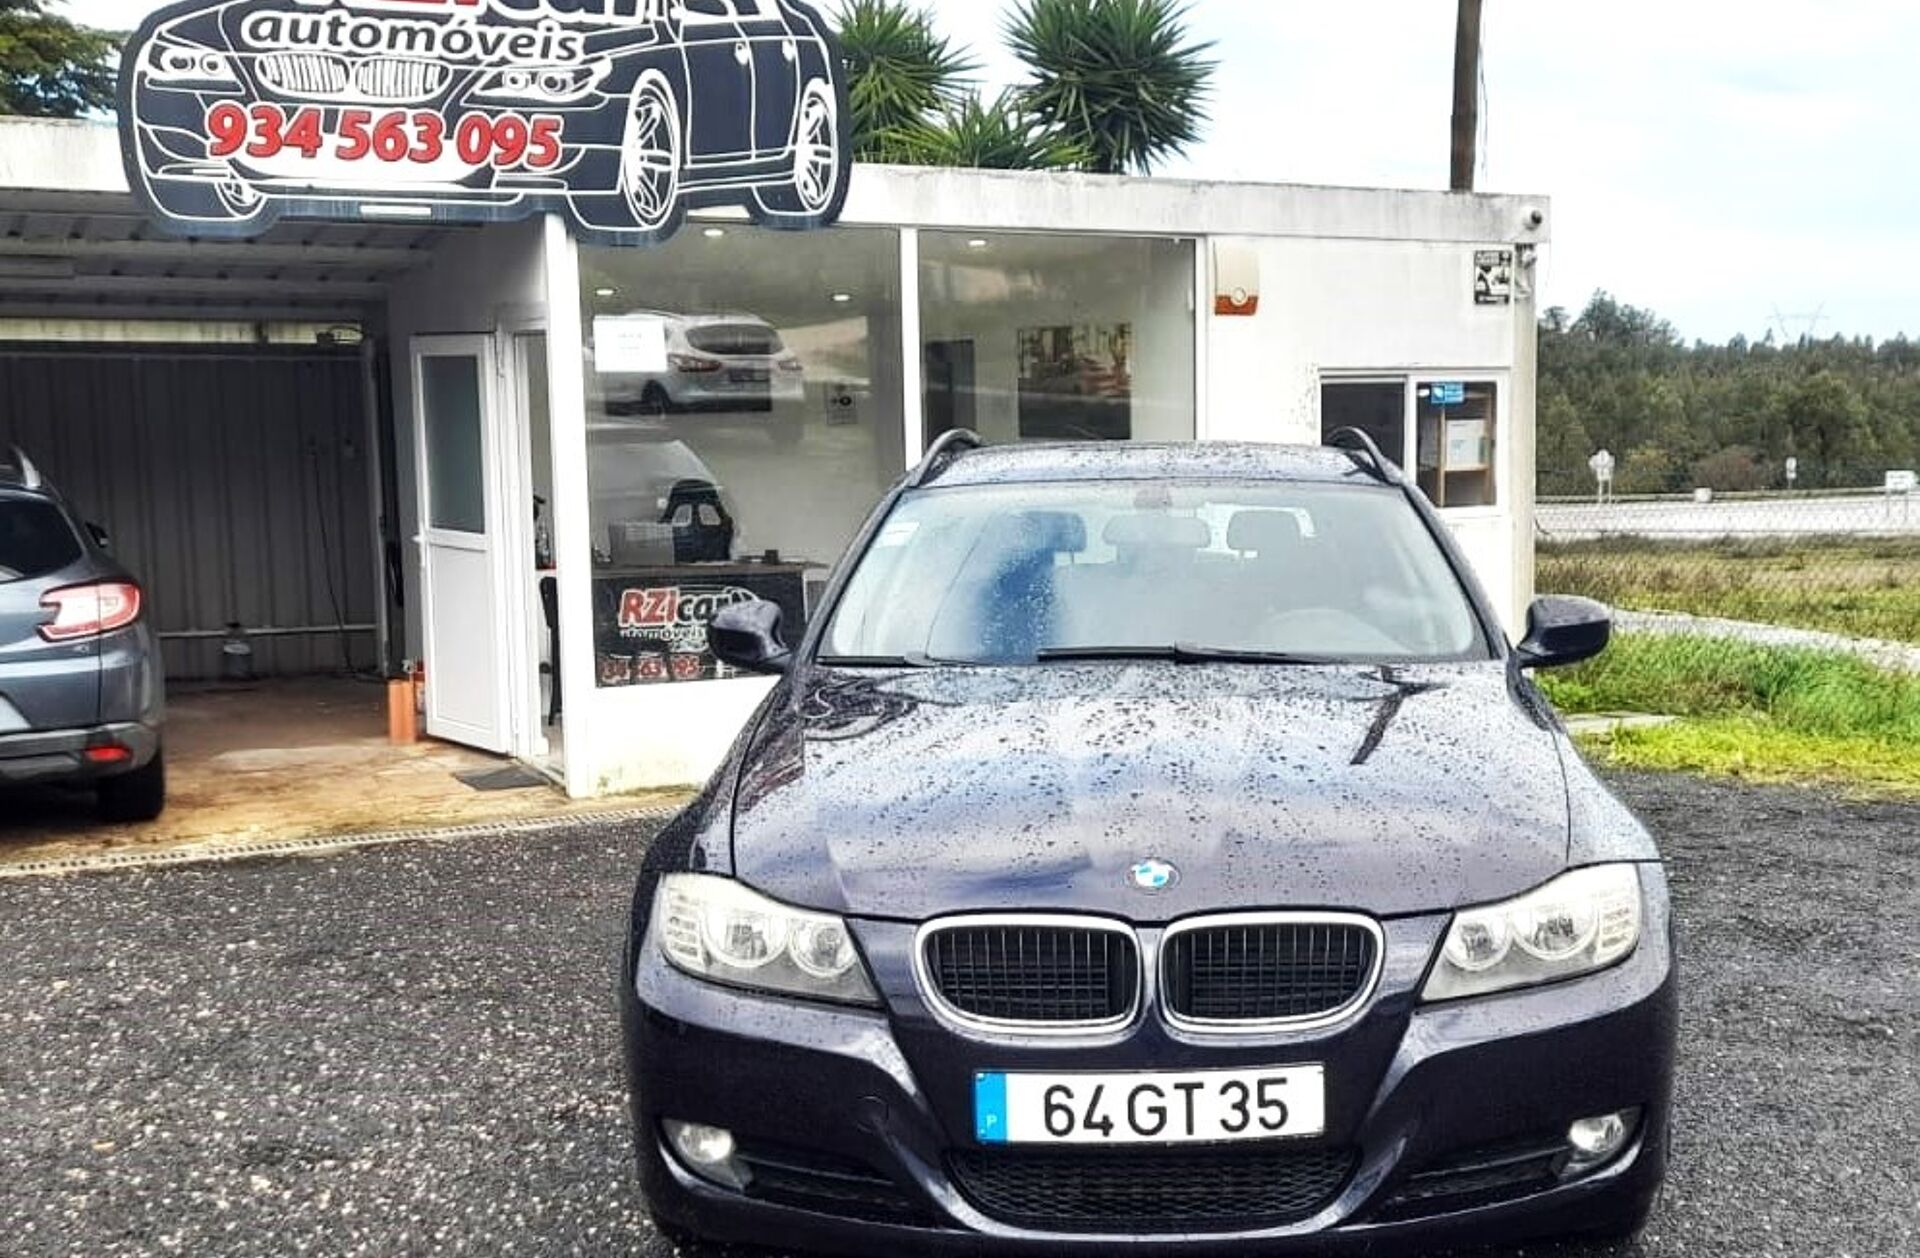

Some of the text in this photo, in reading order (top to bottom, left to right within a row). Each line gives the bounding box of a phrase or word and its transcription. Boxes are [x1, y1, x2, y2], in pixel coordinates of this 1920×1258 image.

[248, 13, 578, 61] automóveis
[208, 103, 562, 167] 934 563 095
[986, 1115, 998, 1130] P
[1043, 1077, 1288, 1137] 64 GT 35
